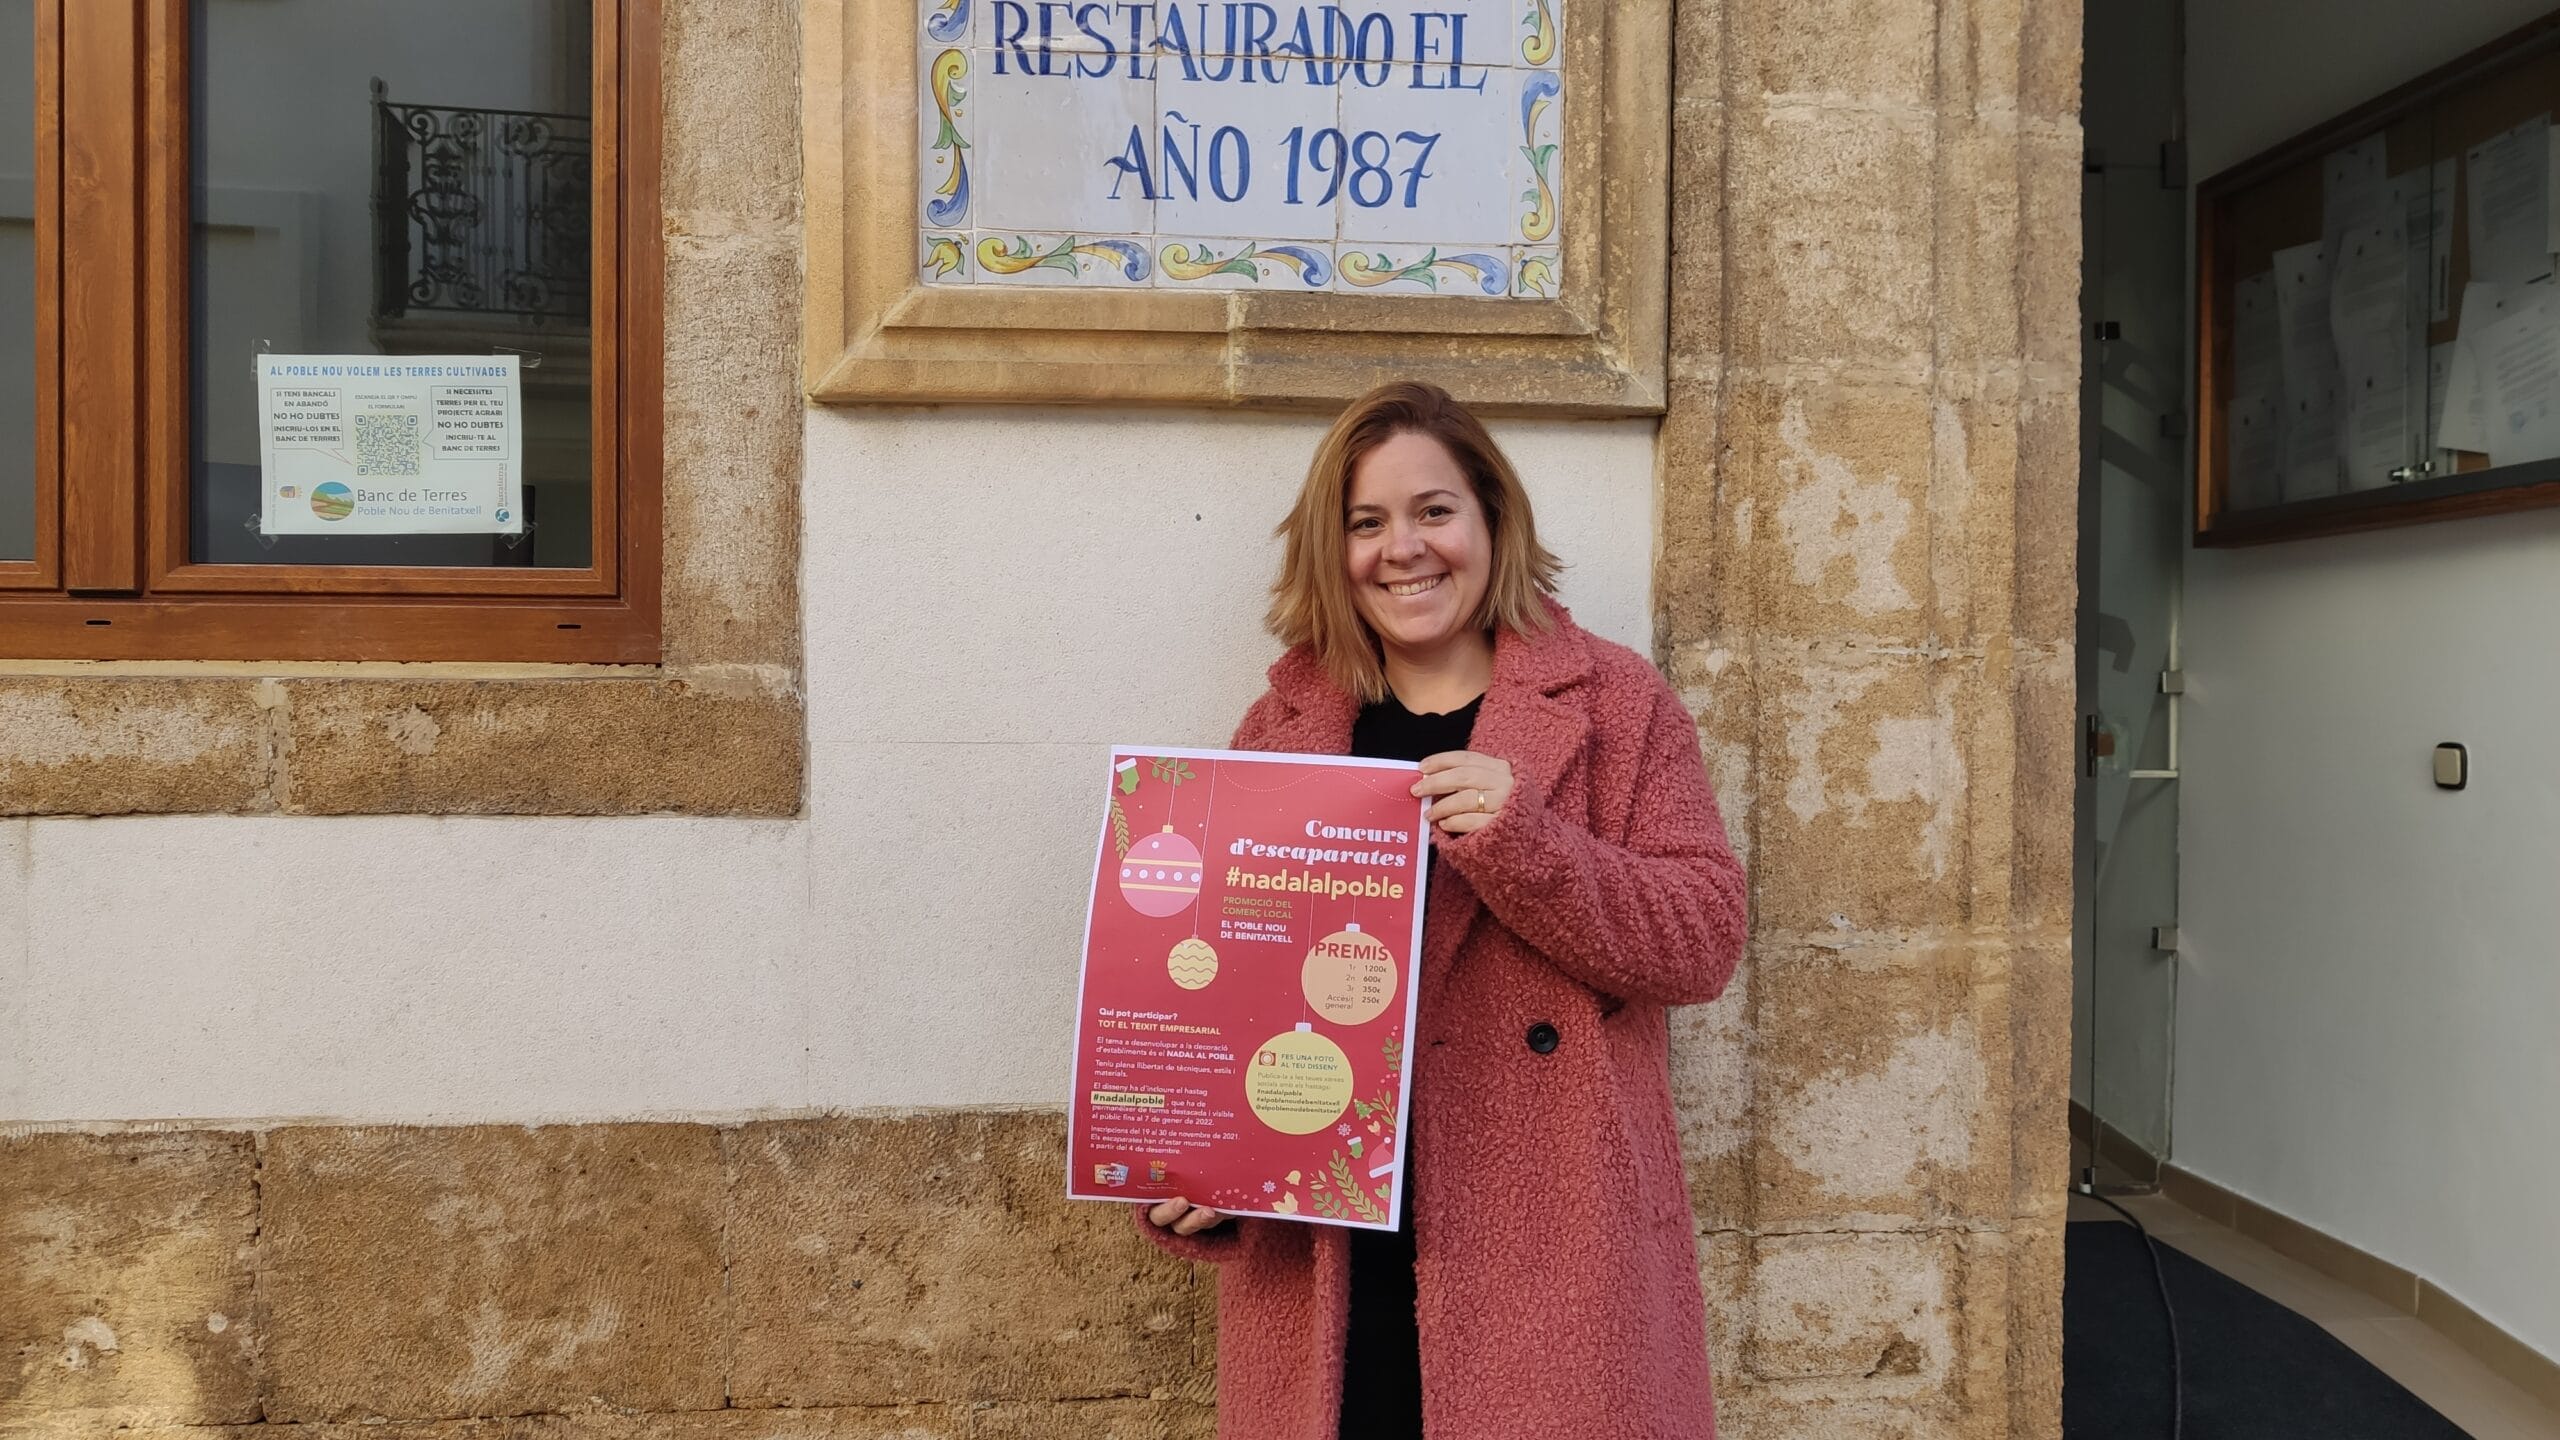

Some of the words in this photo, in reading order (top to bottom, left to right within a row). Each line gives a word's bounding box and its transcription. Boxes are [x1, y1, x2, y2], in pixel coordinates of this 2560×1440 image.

[991, 0, 1394, 87] RESTAURADO
[1408, 13, 1488, 96] EL
[1104, 110, 1250, 203] AÑO
[1278, 126, 1442, 208] 1987
[270, 366, 282, 376] AL
[286, 366, 318, 376] POBLE
[322, 366, 342, 376] NOU
[346, 366, 380, 376] VOLEM
[384, 367, 402, 376] LES
[406, 367, 442, 376] TERRES
[446, 367, 507, 376] CULTIVADES
[357, 489, 394, 502] Banc
[398, 488, 417, 502] de
[422, 488, 468, 502] Terres
[358, 506, 386, 516] Poble
[390, 506, 410, 516] Nou
[416, 506, 426, 516] de
[429, 506, 482, 516] Benitatxell
[1305, 820, 1409, 844] Concurs
[1226, 866, 1404, 900] #nadalalpoble
[1223, 896, 1272, 907] PROMOCIÓ
[1275, 900, 1292, 908] DEL
[1222, 907, 1262, 918] COMERÇ
[1264, 910, 1293, 919] LOCAL
[1221, 920, 1232, 929] EL
[1234, 921, 1264, 931] POBLE
[1265, 923, 1287, 932] NOU
[1220, 931, 1233, 939] DE
[1235, 932, 1293, 943] BENITATXELL
[1315, 942, 1388, 961] PREMIS
[1099, 1008, 1114, 1016] Qui
[1116, 1010, 1130, 1018] pot
[1133, 1011, 1178, 1021] participar?
[1098, 1020, 1115, 1028] TOT
[1131, 1022, 1158, 1031] TEIXIT
[1160, 1024, 1220, 1035] EMPRESARIAL
[1131, 1039, 1178, 1049] desenvolupar
[1194, 1044, 1228, 1052] decoració
[1167, 1050, 1194, 1058] NADAL
[1093, 1094, 1164, 1105] #nadalalpoble
